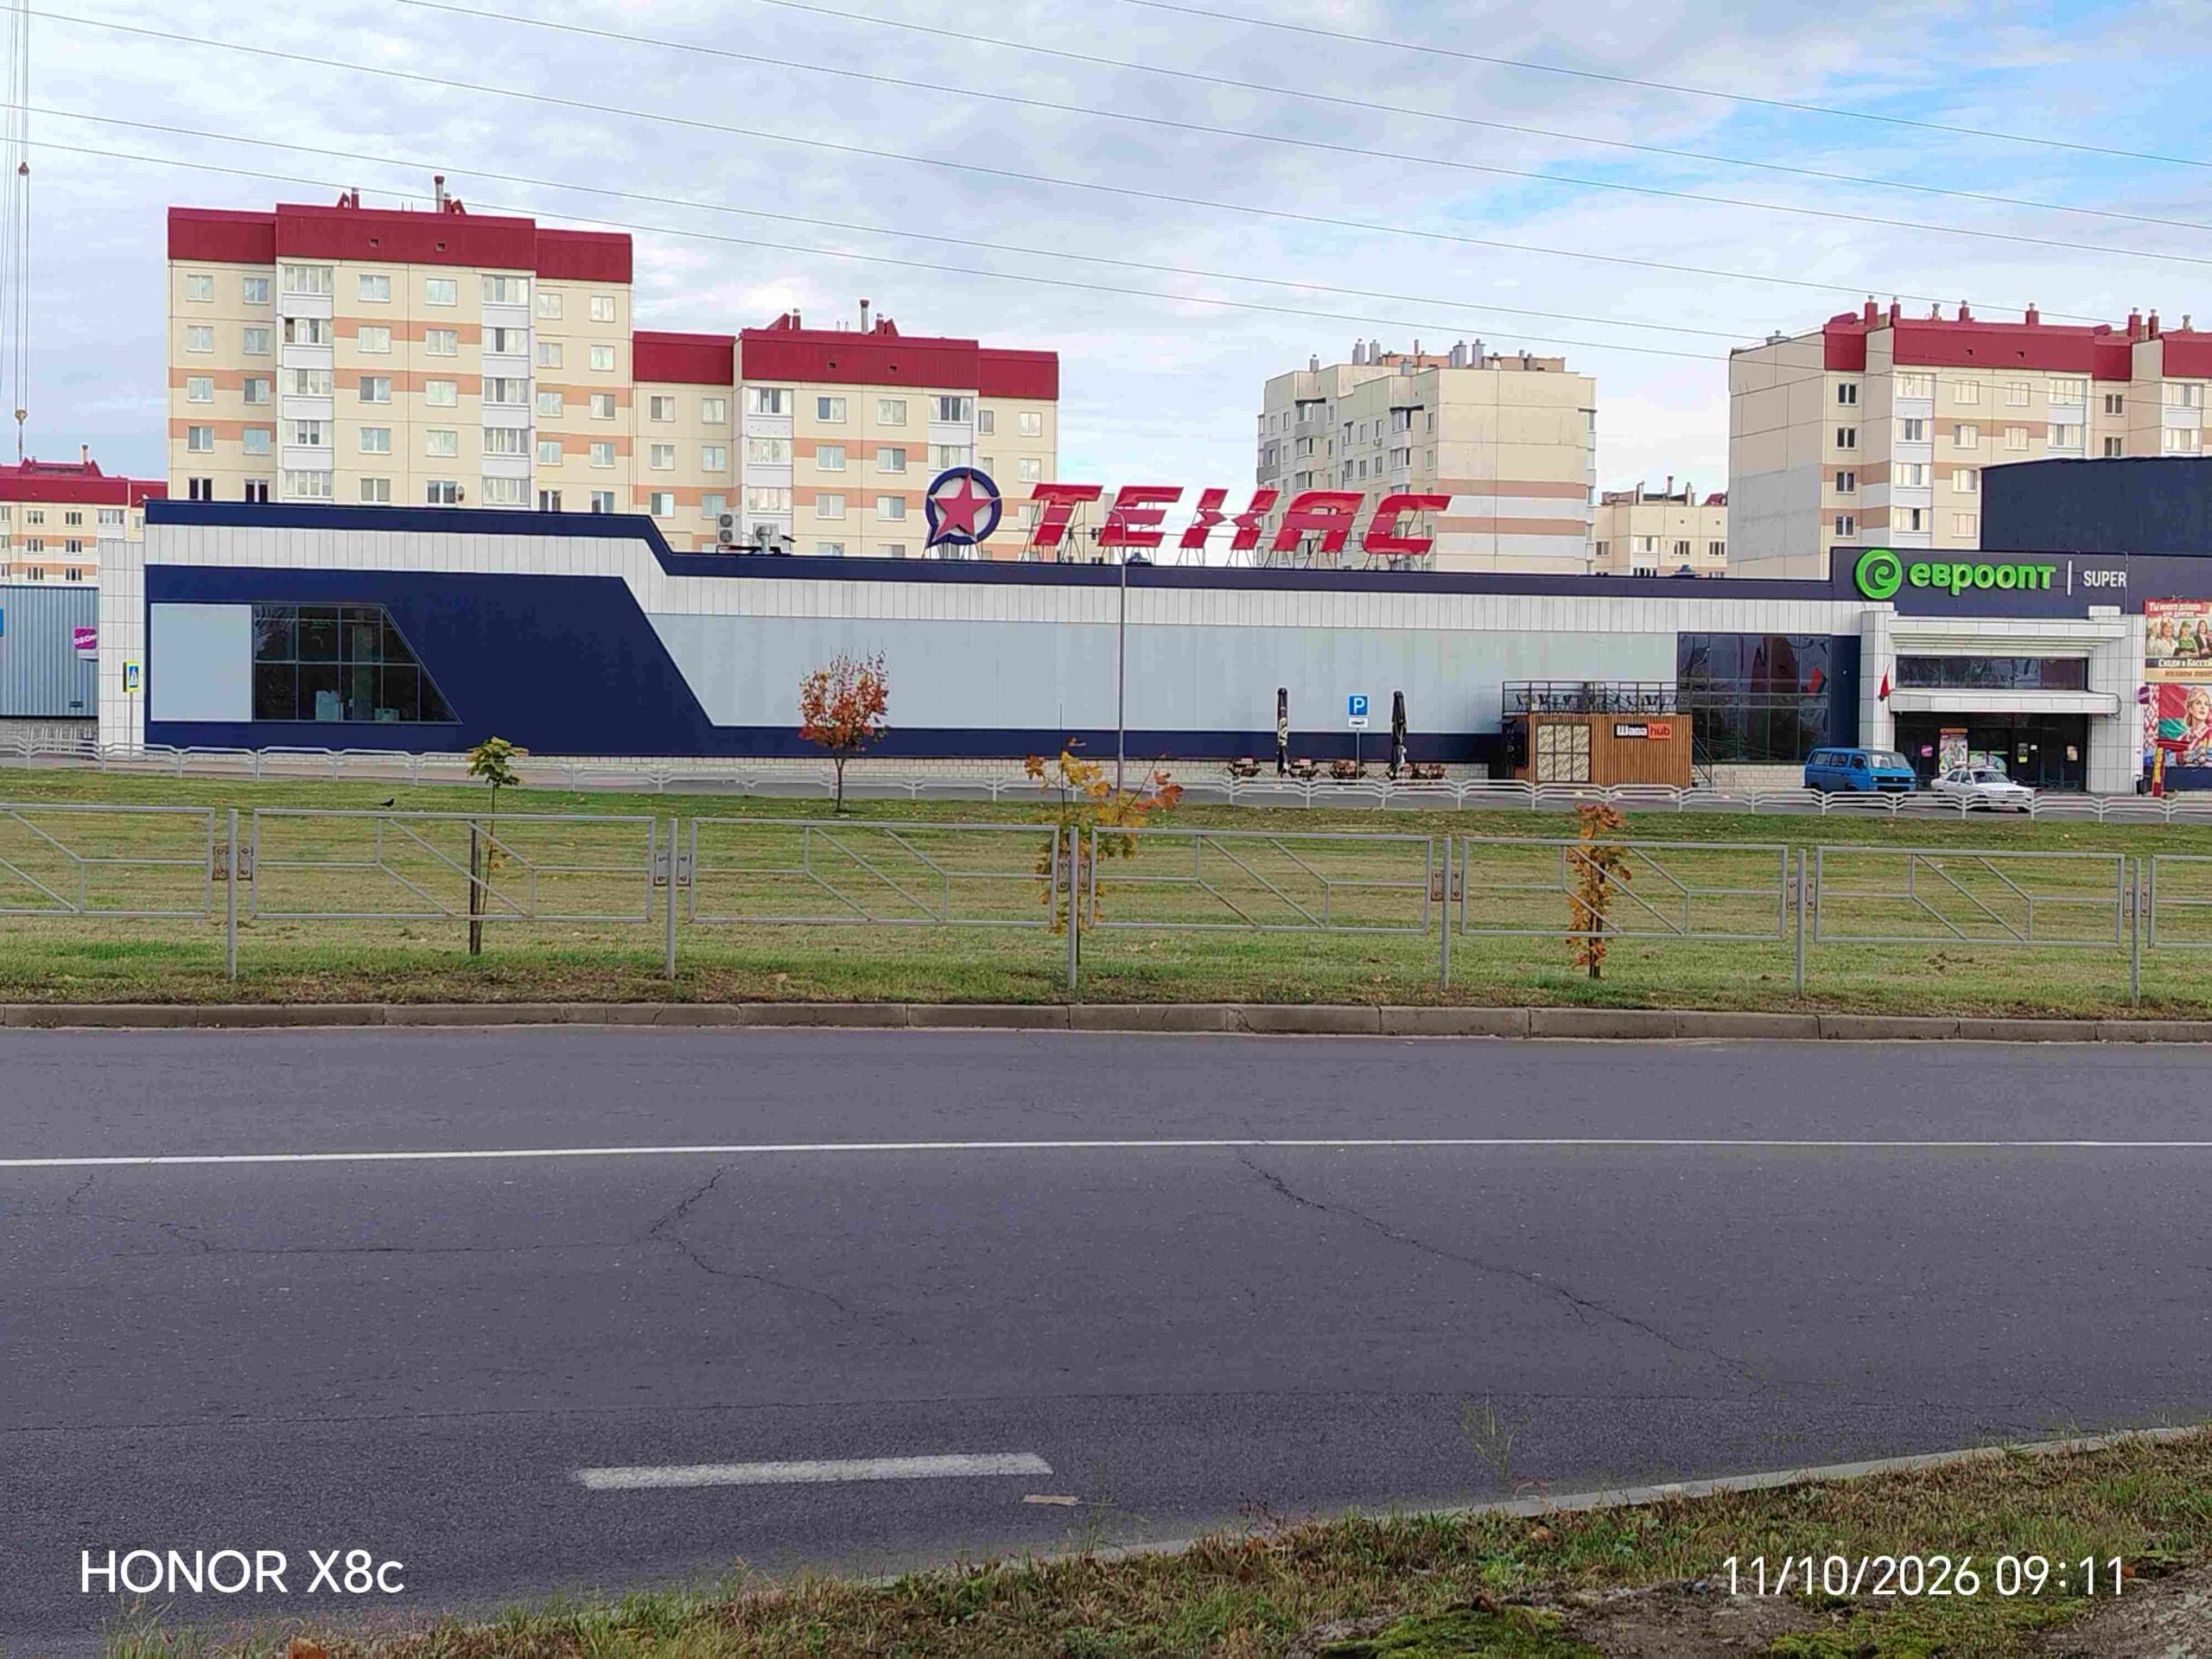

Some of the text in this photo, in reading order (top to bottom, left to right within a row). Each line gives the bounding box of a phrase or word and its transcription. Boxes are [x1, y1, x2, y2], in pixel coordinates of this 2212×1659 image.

[1030, 484, 1452, 556] ТЕХАС
[1909, 562, 2056, 596] евроопт
[2082, 570, 2126, 588] SUPER
